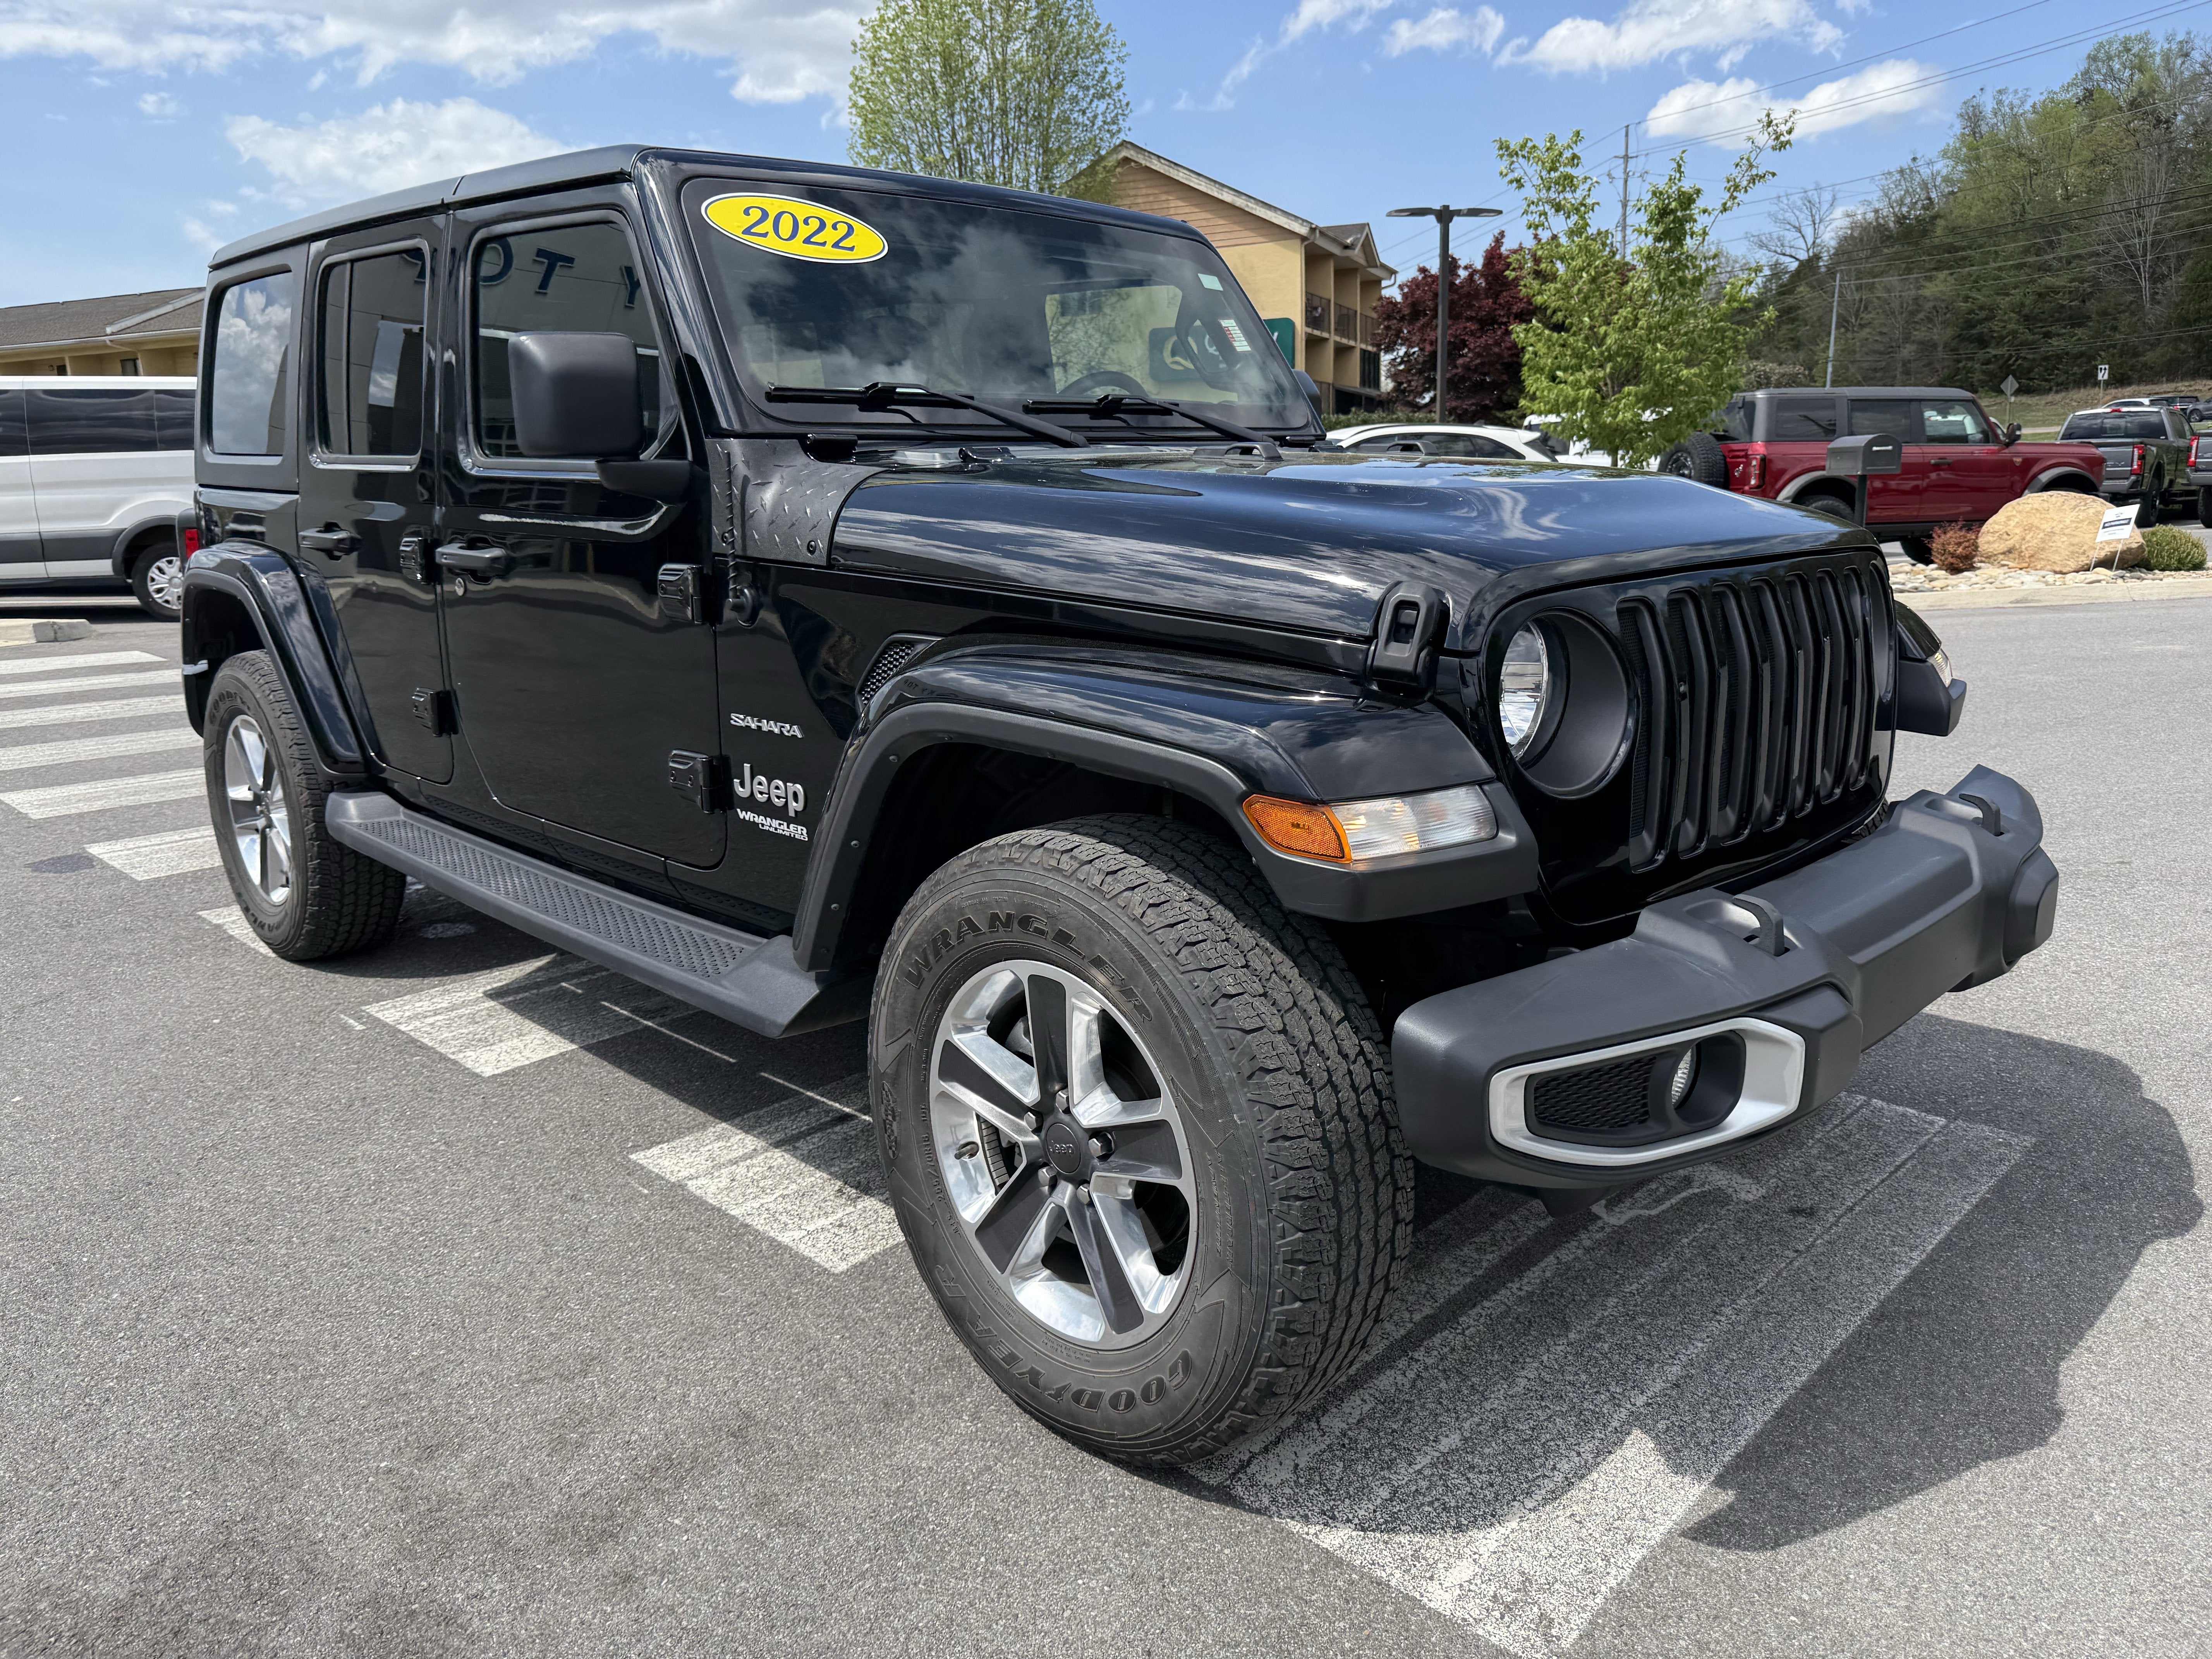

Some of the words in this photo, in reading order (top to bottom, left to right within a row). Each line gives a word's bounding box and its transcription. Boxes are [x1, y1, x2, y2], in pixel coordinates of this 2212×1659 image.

[742, 206, 855, 252] 2022
[730, 713, 805, 738] SAHARA
[733, 763, 807, 817] Jeep
[737, 808, 807, 836] WRANGLER
[759, 823, 809, 842] UNLIMITED
[904, 910, 1153, 1024] WRANGLER
[1049, 1140, 1075, 1157] Jeep
[936, 1264, 1192, 1413] GOODYEAR
